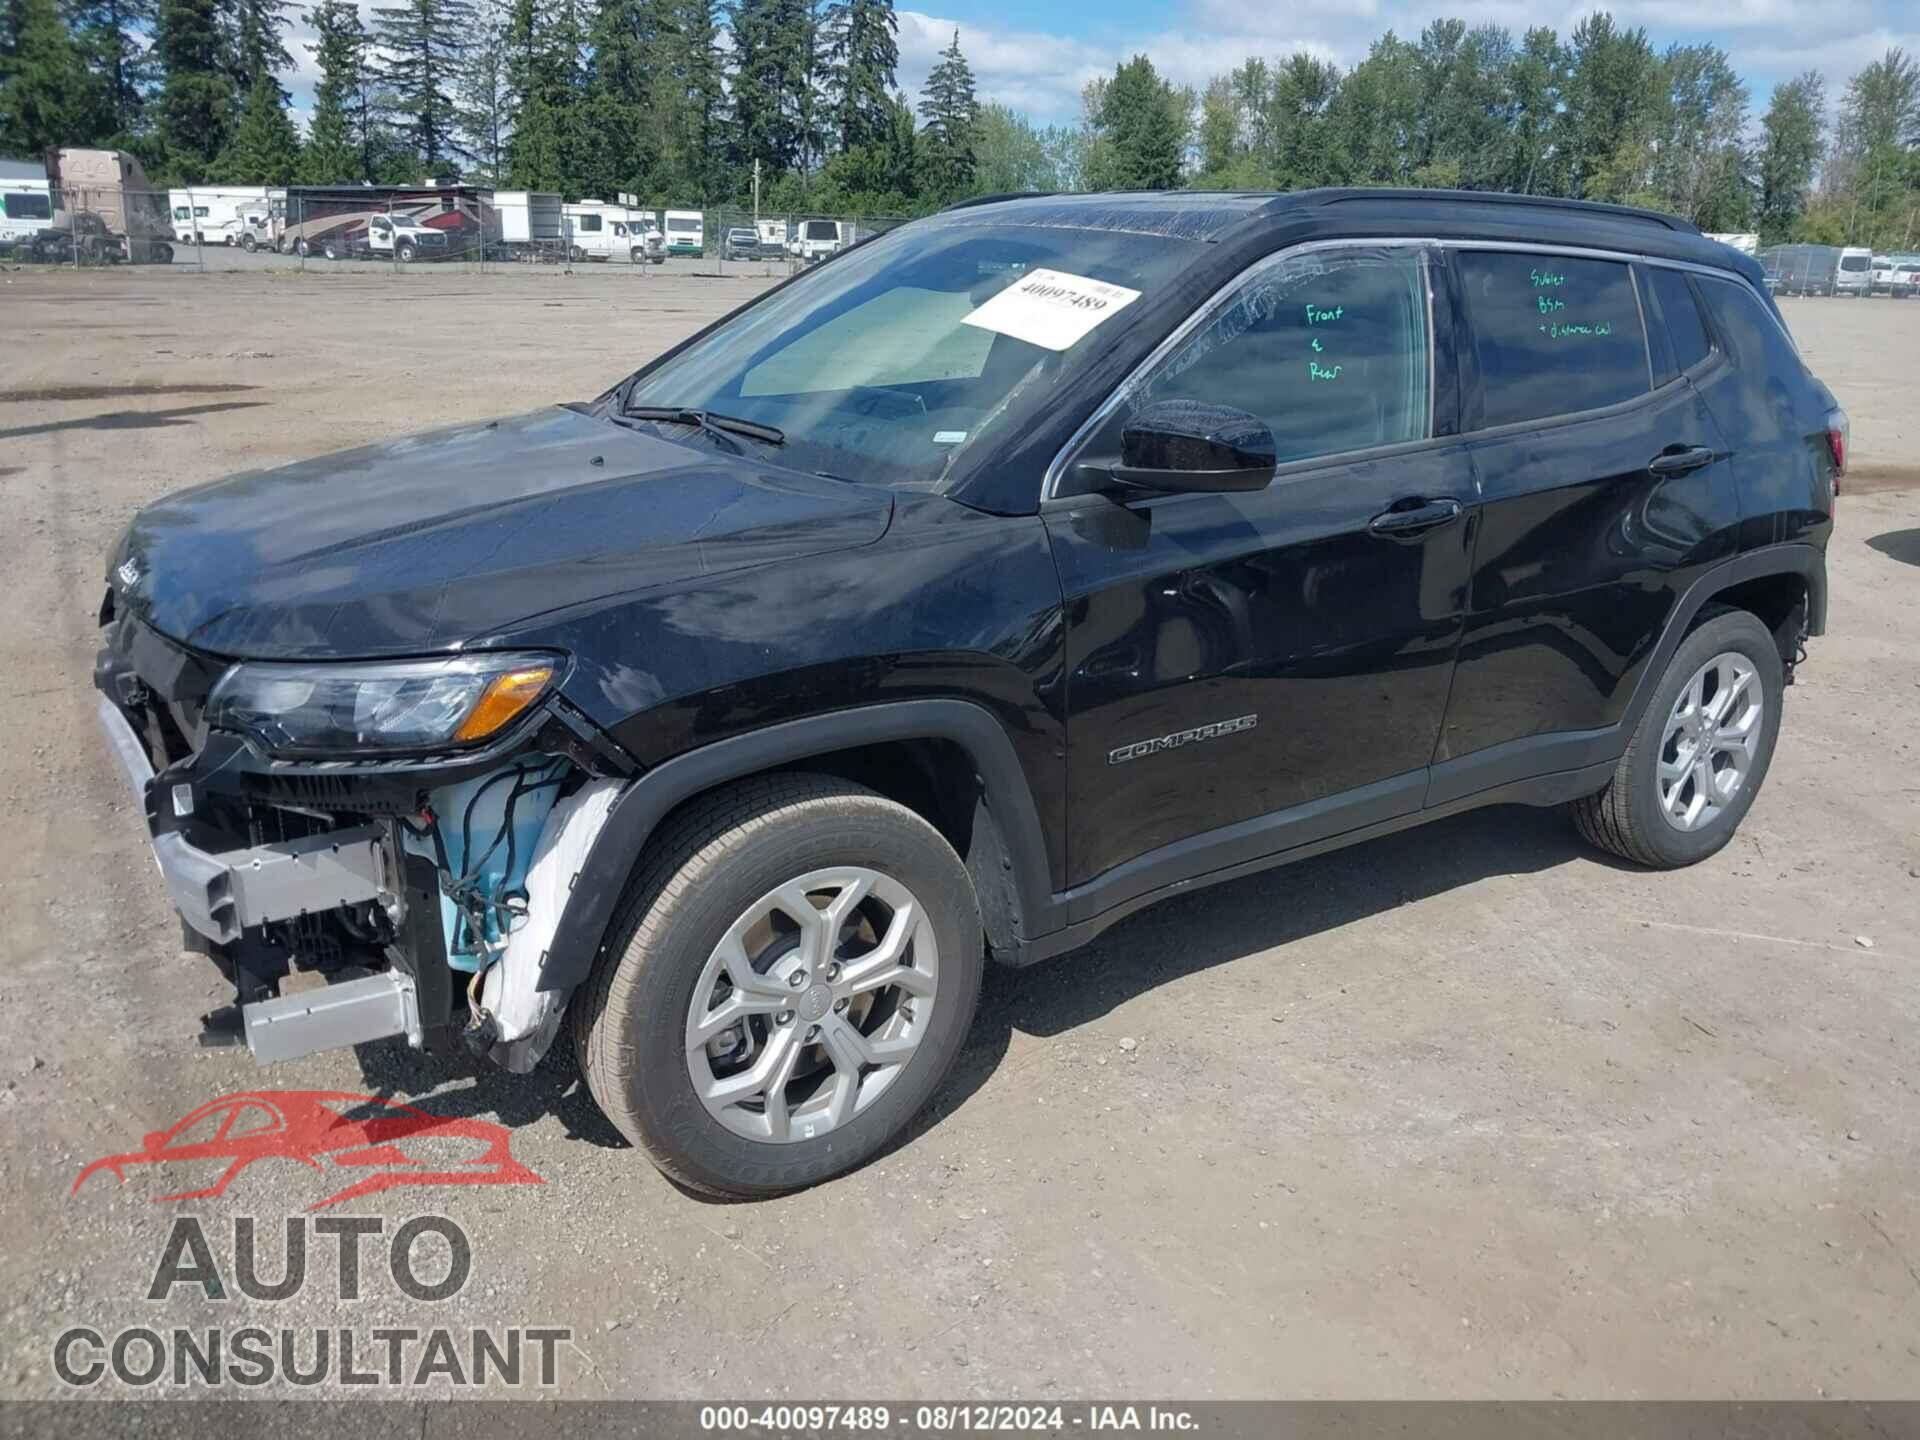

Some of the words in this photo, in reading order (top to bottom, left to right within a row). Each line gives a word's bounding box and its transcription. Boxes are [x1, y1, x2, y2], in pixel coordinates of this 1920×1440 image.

[1020, 281, 1109, 311] 40097489
[1305, 303, 1344, 325] Front
[1108, 714, 1259, 765] COMPASS
